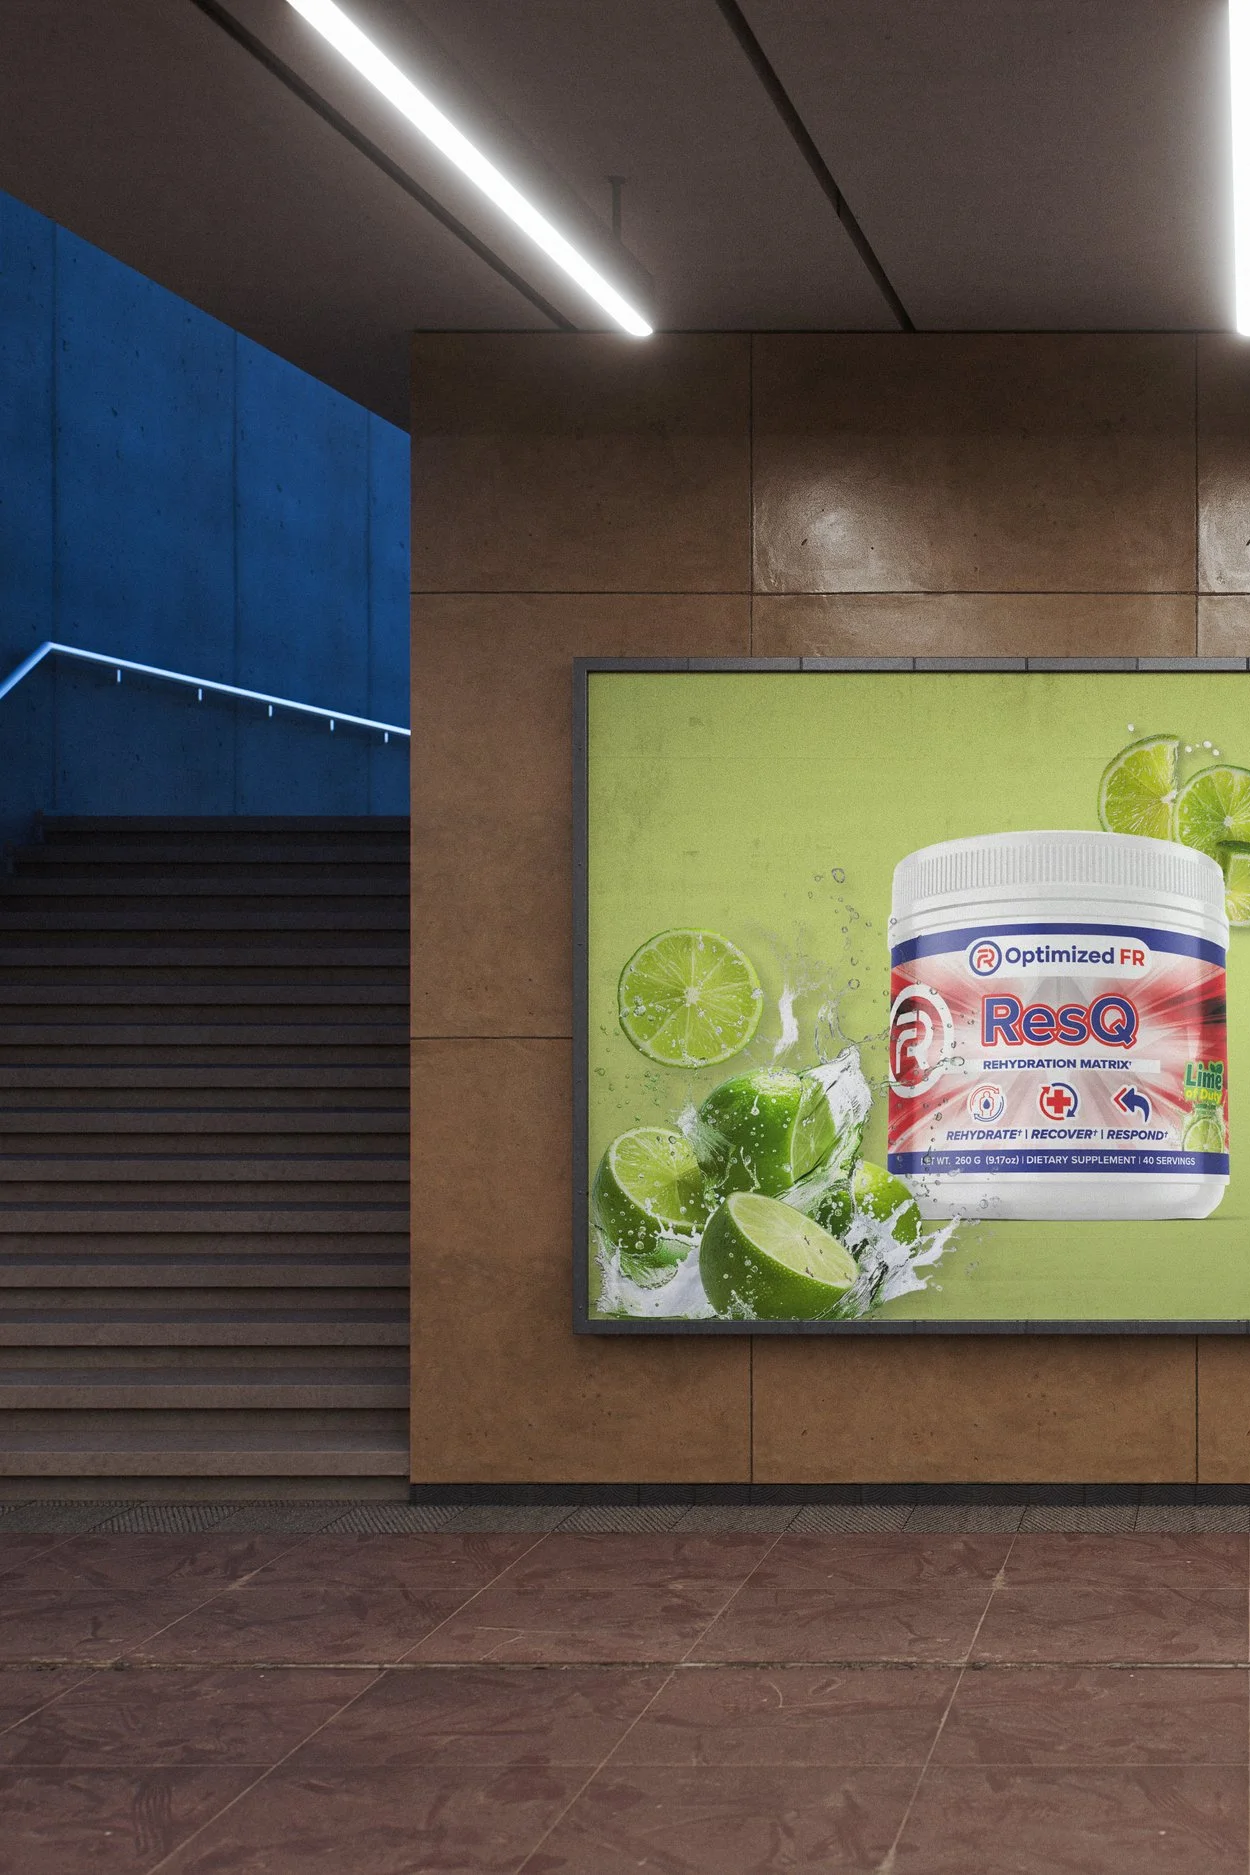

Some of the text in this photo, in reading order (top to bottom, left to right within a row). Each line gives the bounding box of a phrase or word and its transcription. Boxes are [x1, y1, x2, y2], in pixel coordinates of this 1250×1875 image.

[1005, 945, 1115, 967] Optimized
[1120, 949, 1145, 967] FR
[981, 992, 1141, 1049] ResQ
[983, 1059, 1077, 1070] REHYDRATION
[1185, 1063, 1223, 1091] Lime
[1200, 1089, 1221, 1105] Duty
[937, 1156, 951, 1165] WT.
[955, 1156, 972, 1165] 260
[973, 1156, 981, 1165] G
[1026, 1155, 1069, 1165] DIETARY
[1071, 1155, 1136, 1165] SUPPLEMENT
[1143, 1156, 1154, 1165] 40
[1156, 1156, 1196, 1166] SERVINGS
